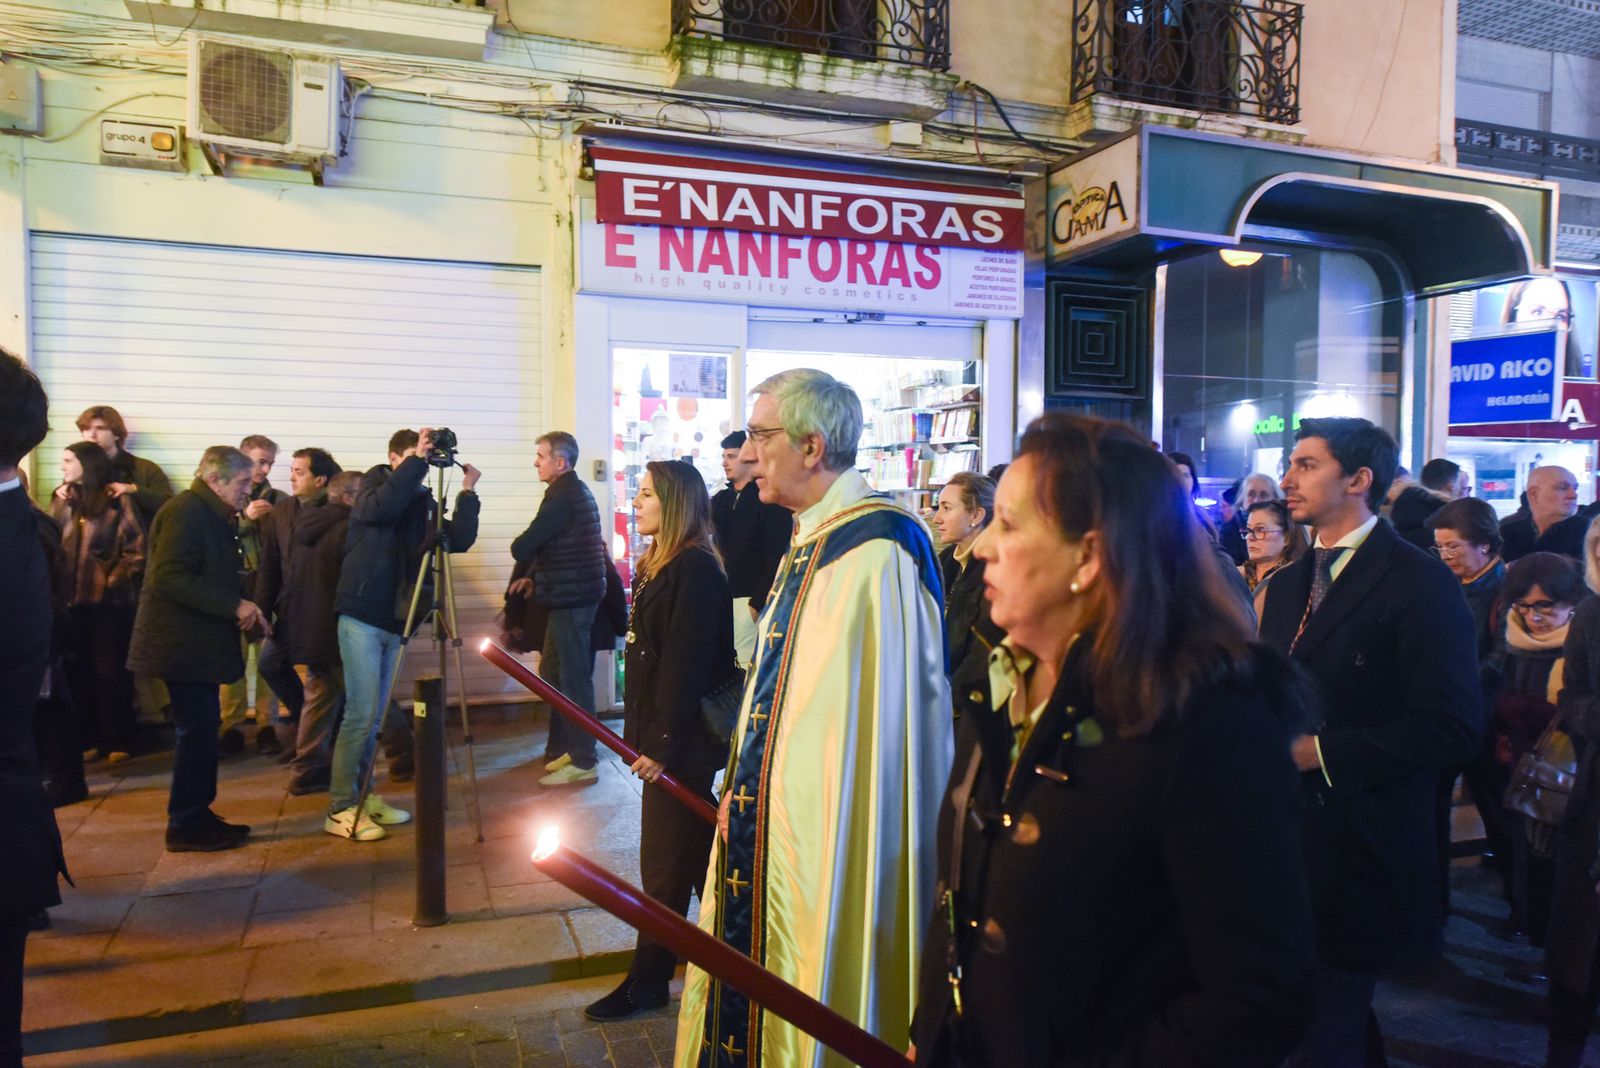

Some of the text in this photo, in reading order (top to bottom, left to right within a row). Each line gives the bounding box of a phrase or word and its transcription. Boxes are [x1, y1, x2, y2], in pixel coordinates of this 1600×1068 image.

[106, 132, 145, 144] grupo 4
[1052, 181, 1128, 244] GAMA
[605, 222, 942, 290] ENANFORAS
[634, 272, 917, 302] high quality cosmetics
[1450, 357, 1553, 383] AVID RICO
